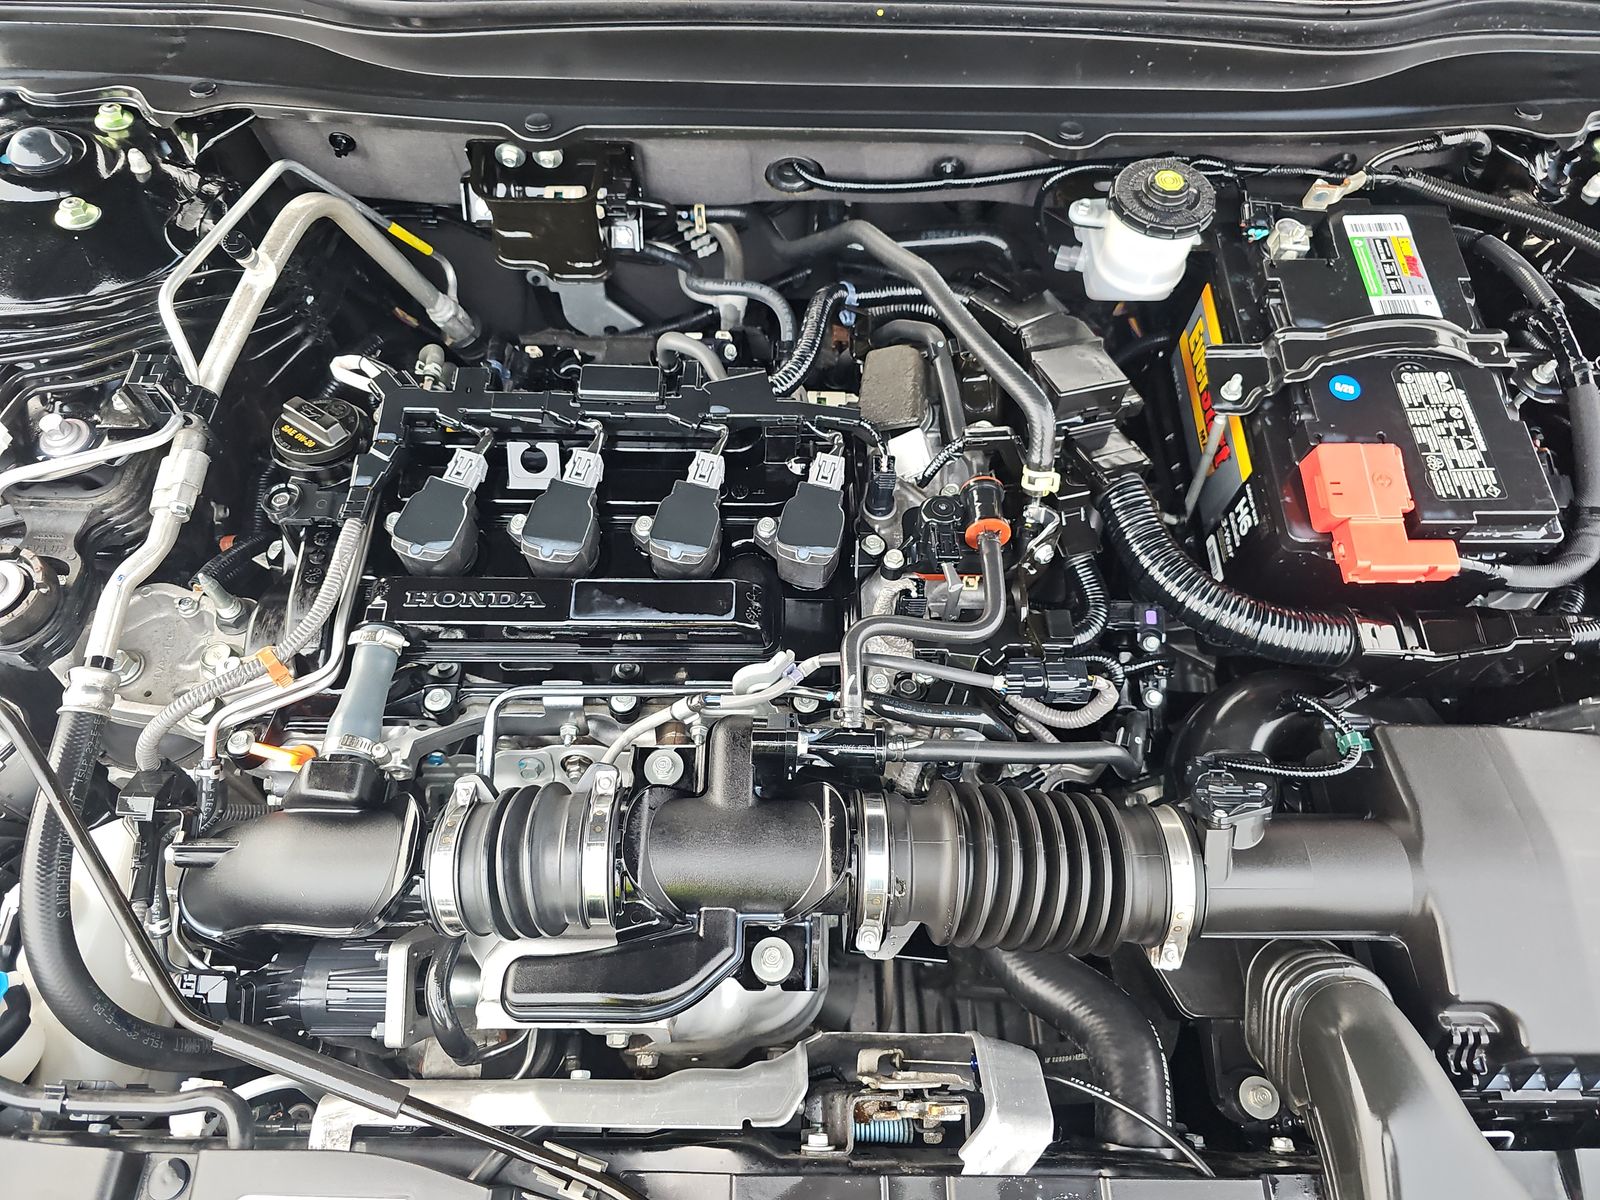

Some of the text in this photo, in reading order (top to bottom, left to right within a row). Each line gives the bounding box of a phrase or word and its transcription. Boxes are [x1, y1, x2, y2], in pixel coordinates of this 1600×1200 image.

[281, 424, 298, 437] SAE
[293, 433, 316, 448] 0W-20
[1234, 496, 1253, 537] H6
[1221, 518, 1234, 558] 3-Year
[402, 590, 546, 609] HONDA
